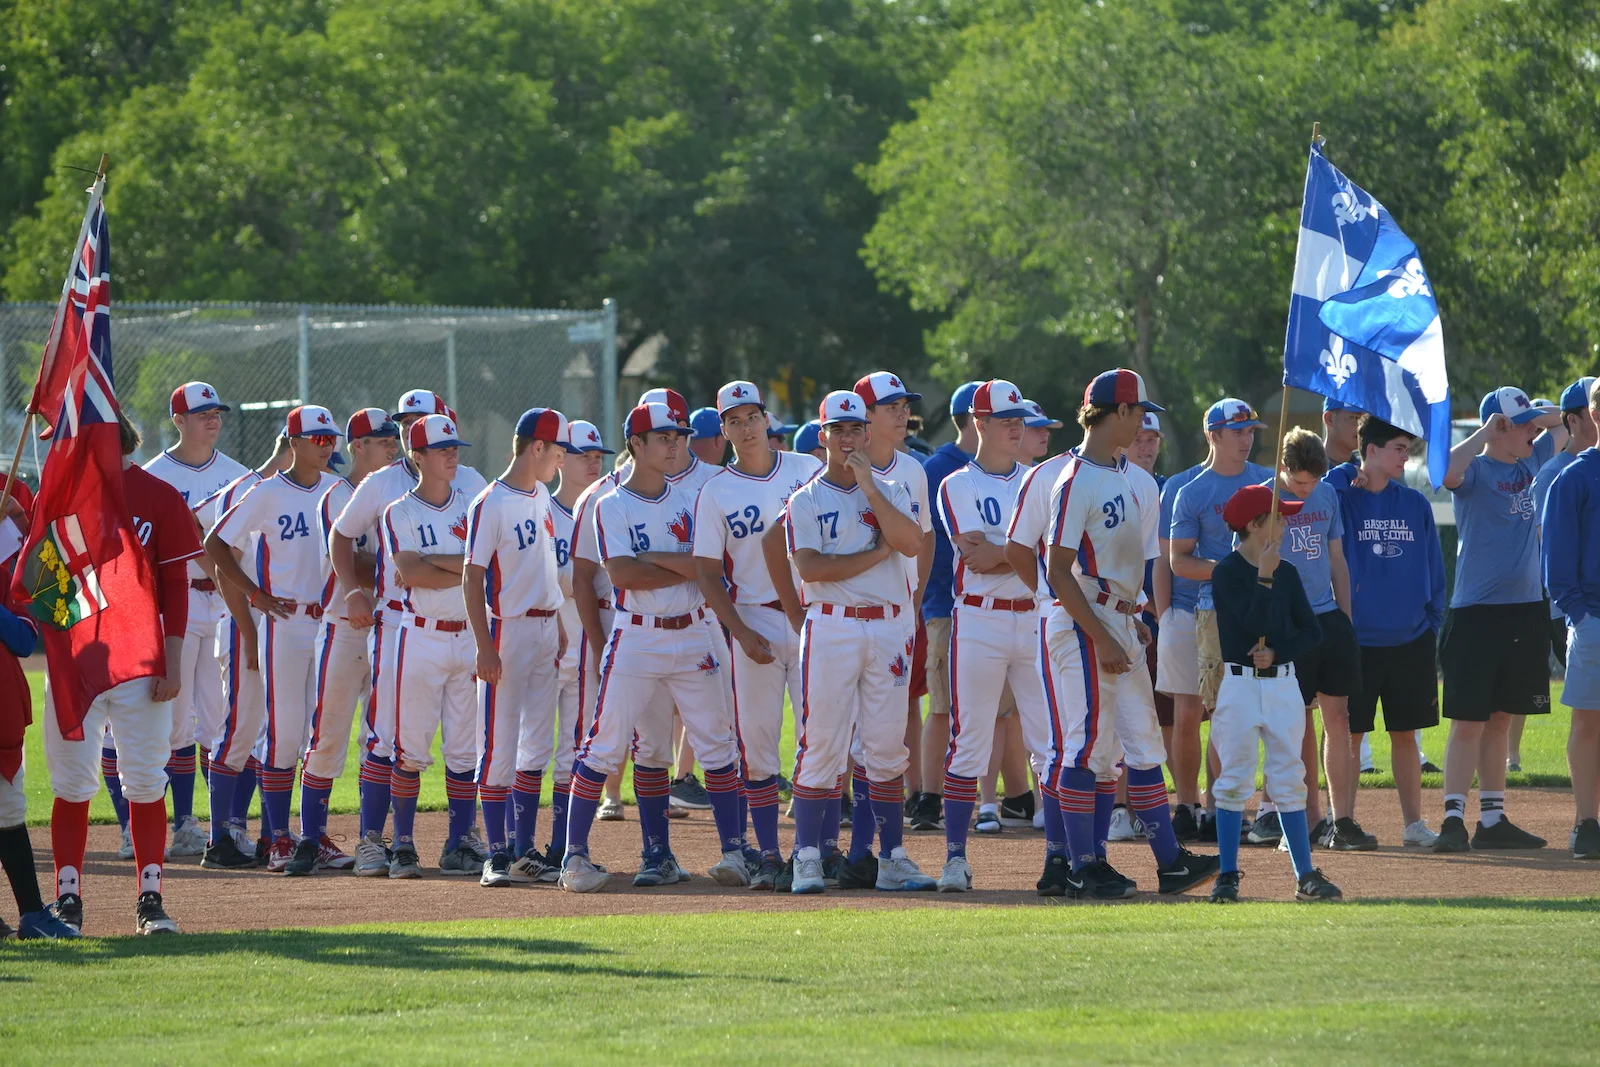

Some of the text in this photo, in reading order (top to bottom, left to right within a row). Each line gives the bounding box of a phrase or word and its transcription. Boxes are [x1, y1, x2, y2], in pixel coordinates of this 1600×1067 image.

[278, 511, 310, 541] 24
[725, 504, 765, 539] 52
[1103, 493, 1125, 529] 37
[1363, 518, 1409, 530] BASEBALL
[417, 523, 438, 548] 11
[513, 518, 537, 550] 13
[1289, 525, 1322, 560] NS
[555, 537, 569, 567] 6
